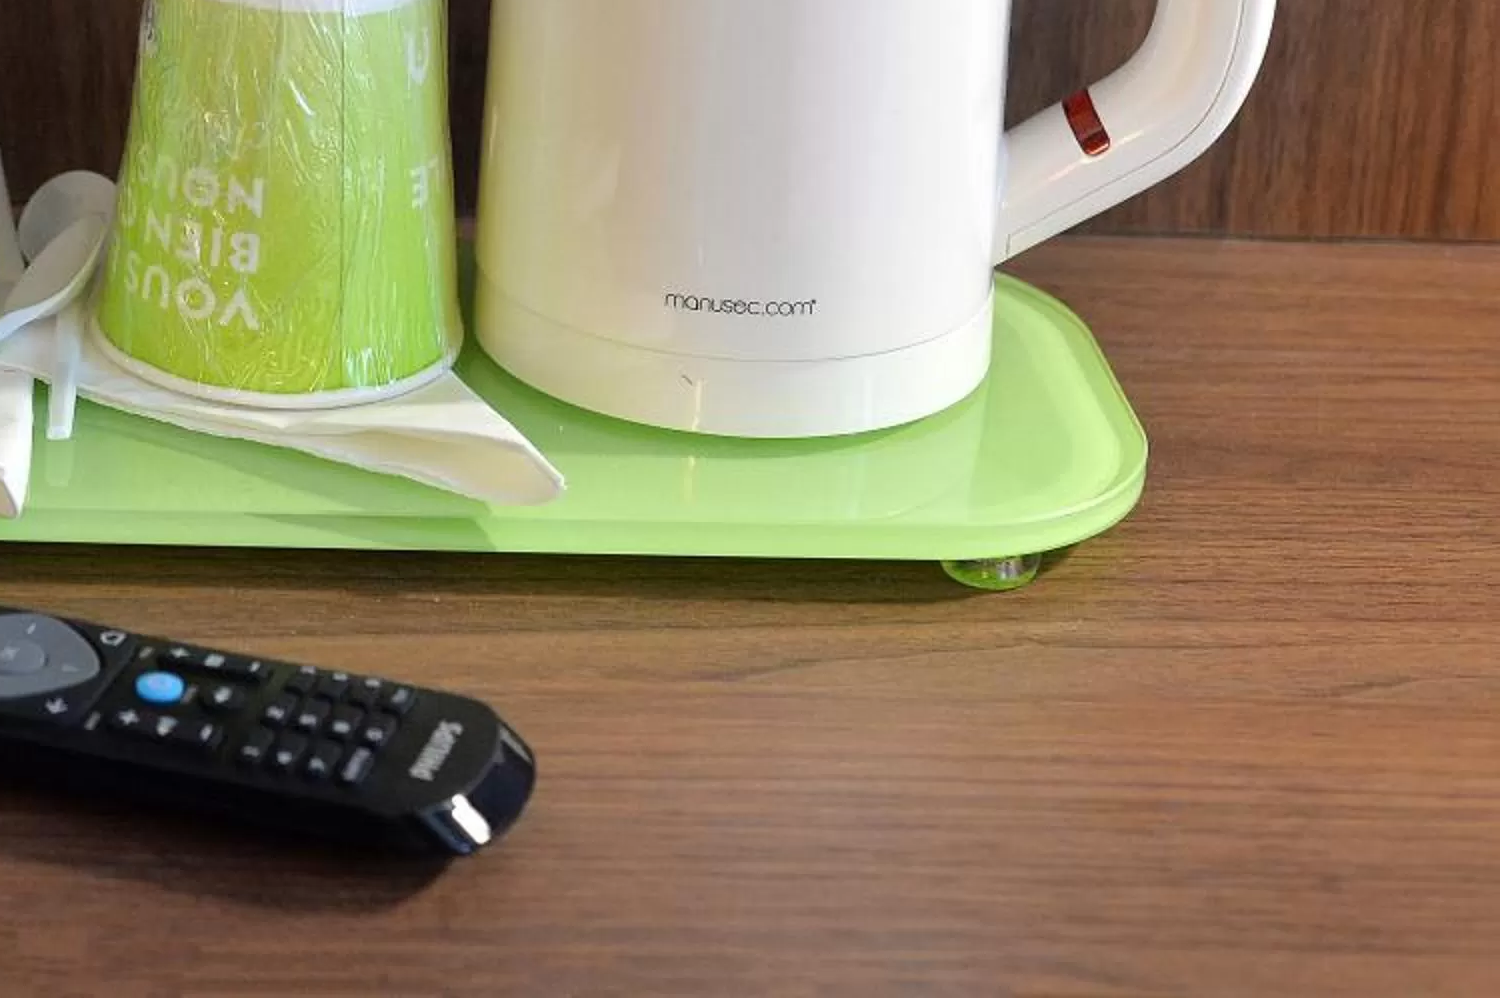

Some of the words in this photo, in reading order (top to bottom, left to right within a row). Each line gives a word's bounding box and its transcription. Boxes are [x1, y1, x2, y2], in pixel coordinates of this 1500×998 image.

[138, 143, 266, 219] NOUS
[143, 207, 261, 275] BIEN
[124, 250, 261, 332] VOUS
